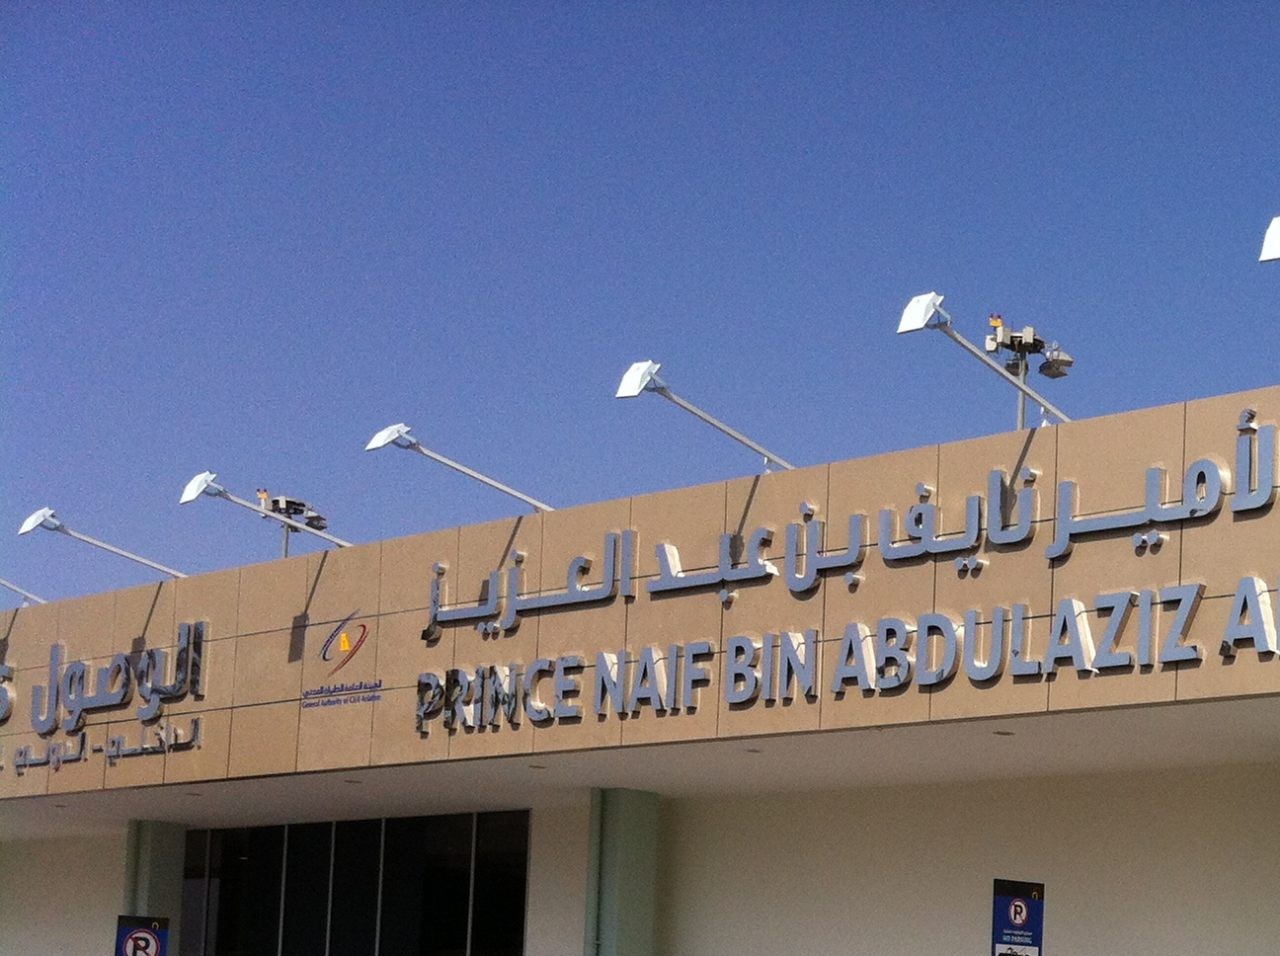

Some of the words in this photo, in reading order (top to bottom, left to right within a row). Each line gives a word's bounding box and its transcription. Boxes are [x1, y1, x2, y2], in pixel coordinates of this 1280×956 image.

[784, 501, 868, 594] بن
[878, 467, 1041, 577] نايف
[31, 622, 208, 738] الوصول
[415, 655, 585, 737] PRINCE
[591, 636, 714, 720] NAIF
[724, 628, 822, 705] BIN
[831, 580, 1206, 695] ABDULAZIZ
